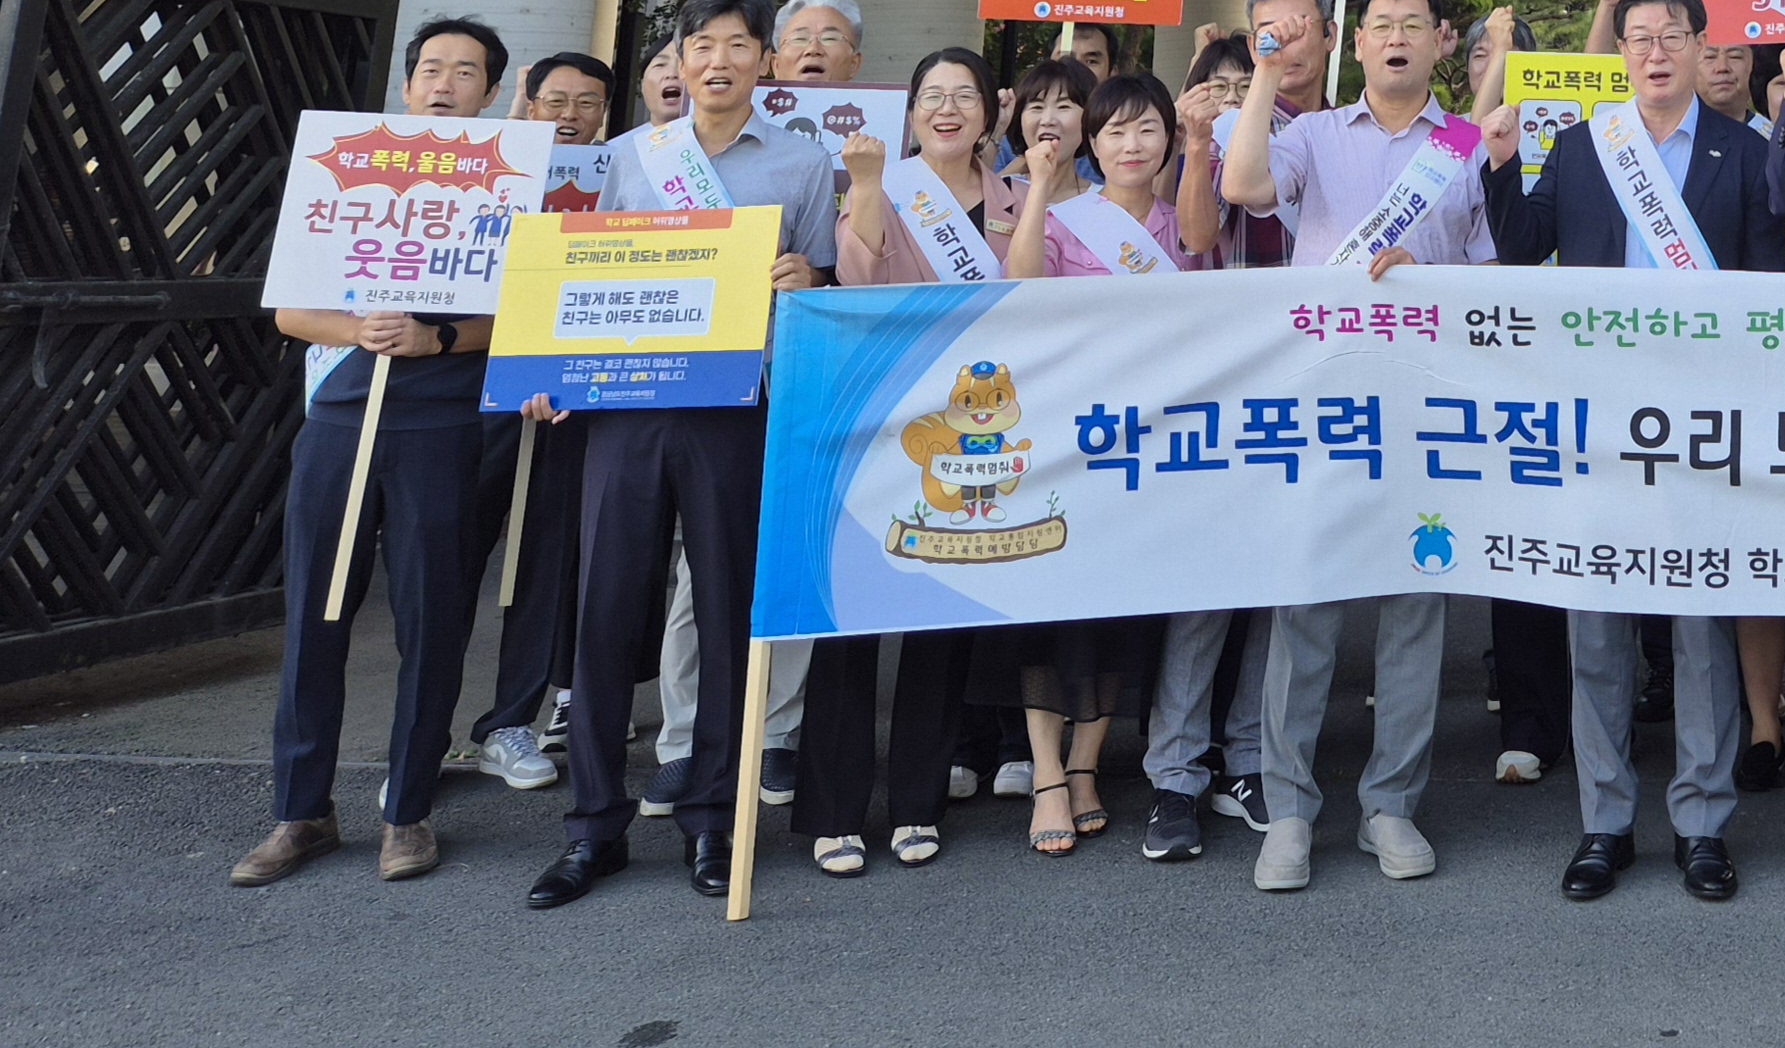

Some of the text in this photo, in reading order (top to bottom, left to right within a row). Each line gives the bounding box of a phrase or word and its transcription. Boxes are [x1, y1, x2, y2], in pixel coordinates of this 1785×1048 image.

[1054, 4, 1125, 18] 진주교육지원청
[1522, 68, 1632, 93] 학교폭력 멈
[594, 155, 611, 173] 신
[304, 198, 466, 241] 친구사랑,
[344, 239, 498, 283] 웃음바다
[565, 248, 718, 265] 친구끼리 이 정도는 괜찮겠지?
[1330, 239, 1360, 265] 혼자
[365, 289, 455, 305] 진주교육지원청
[564, 290, 680, 306] 그렇게 해도 괜찮은
[562, 309, 706, 325] 친구는 아무도 없습니다.
[1289, 303, 1440, 343] 학교폭력
[1464, 304, 1537, 347] 없는
[1560, 307, 1721, 348] 안전하고
[563, 360, 574, 371] 그
[576, 359, 602, 370] 친구는
[652, 357, 690, 369] 않습니다.
[1074, 395, 1384, 492] 학교폭력
[1416, 396, 1590, 487] 근절!
[1619, 406, 1743, 486] 우리
[940, 460, 1010, 475] 학교폭력멈춰
[1484, 533, 1731, 589] 진주교육지원청
